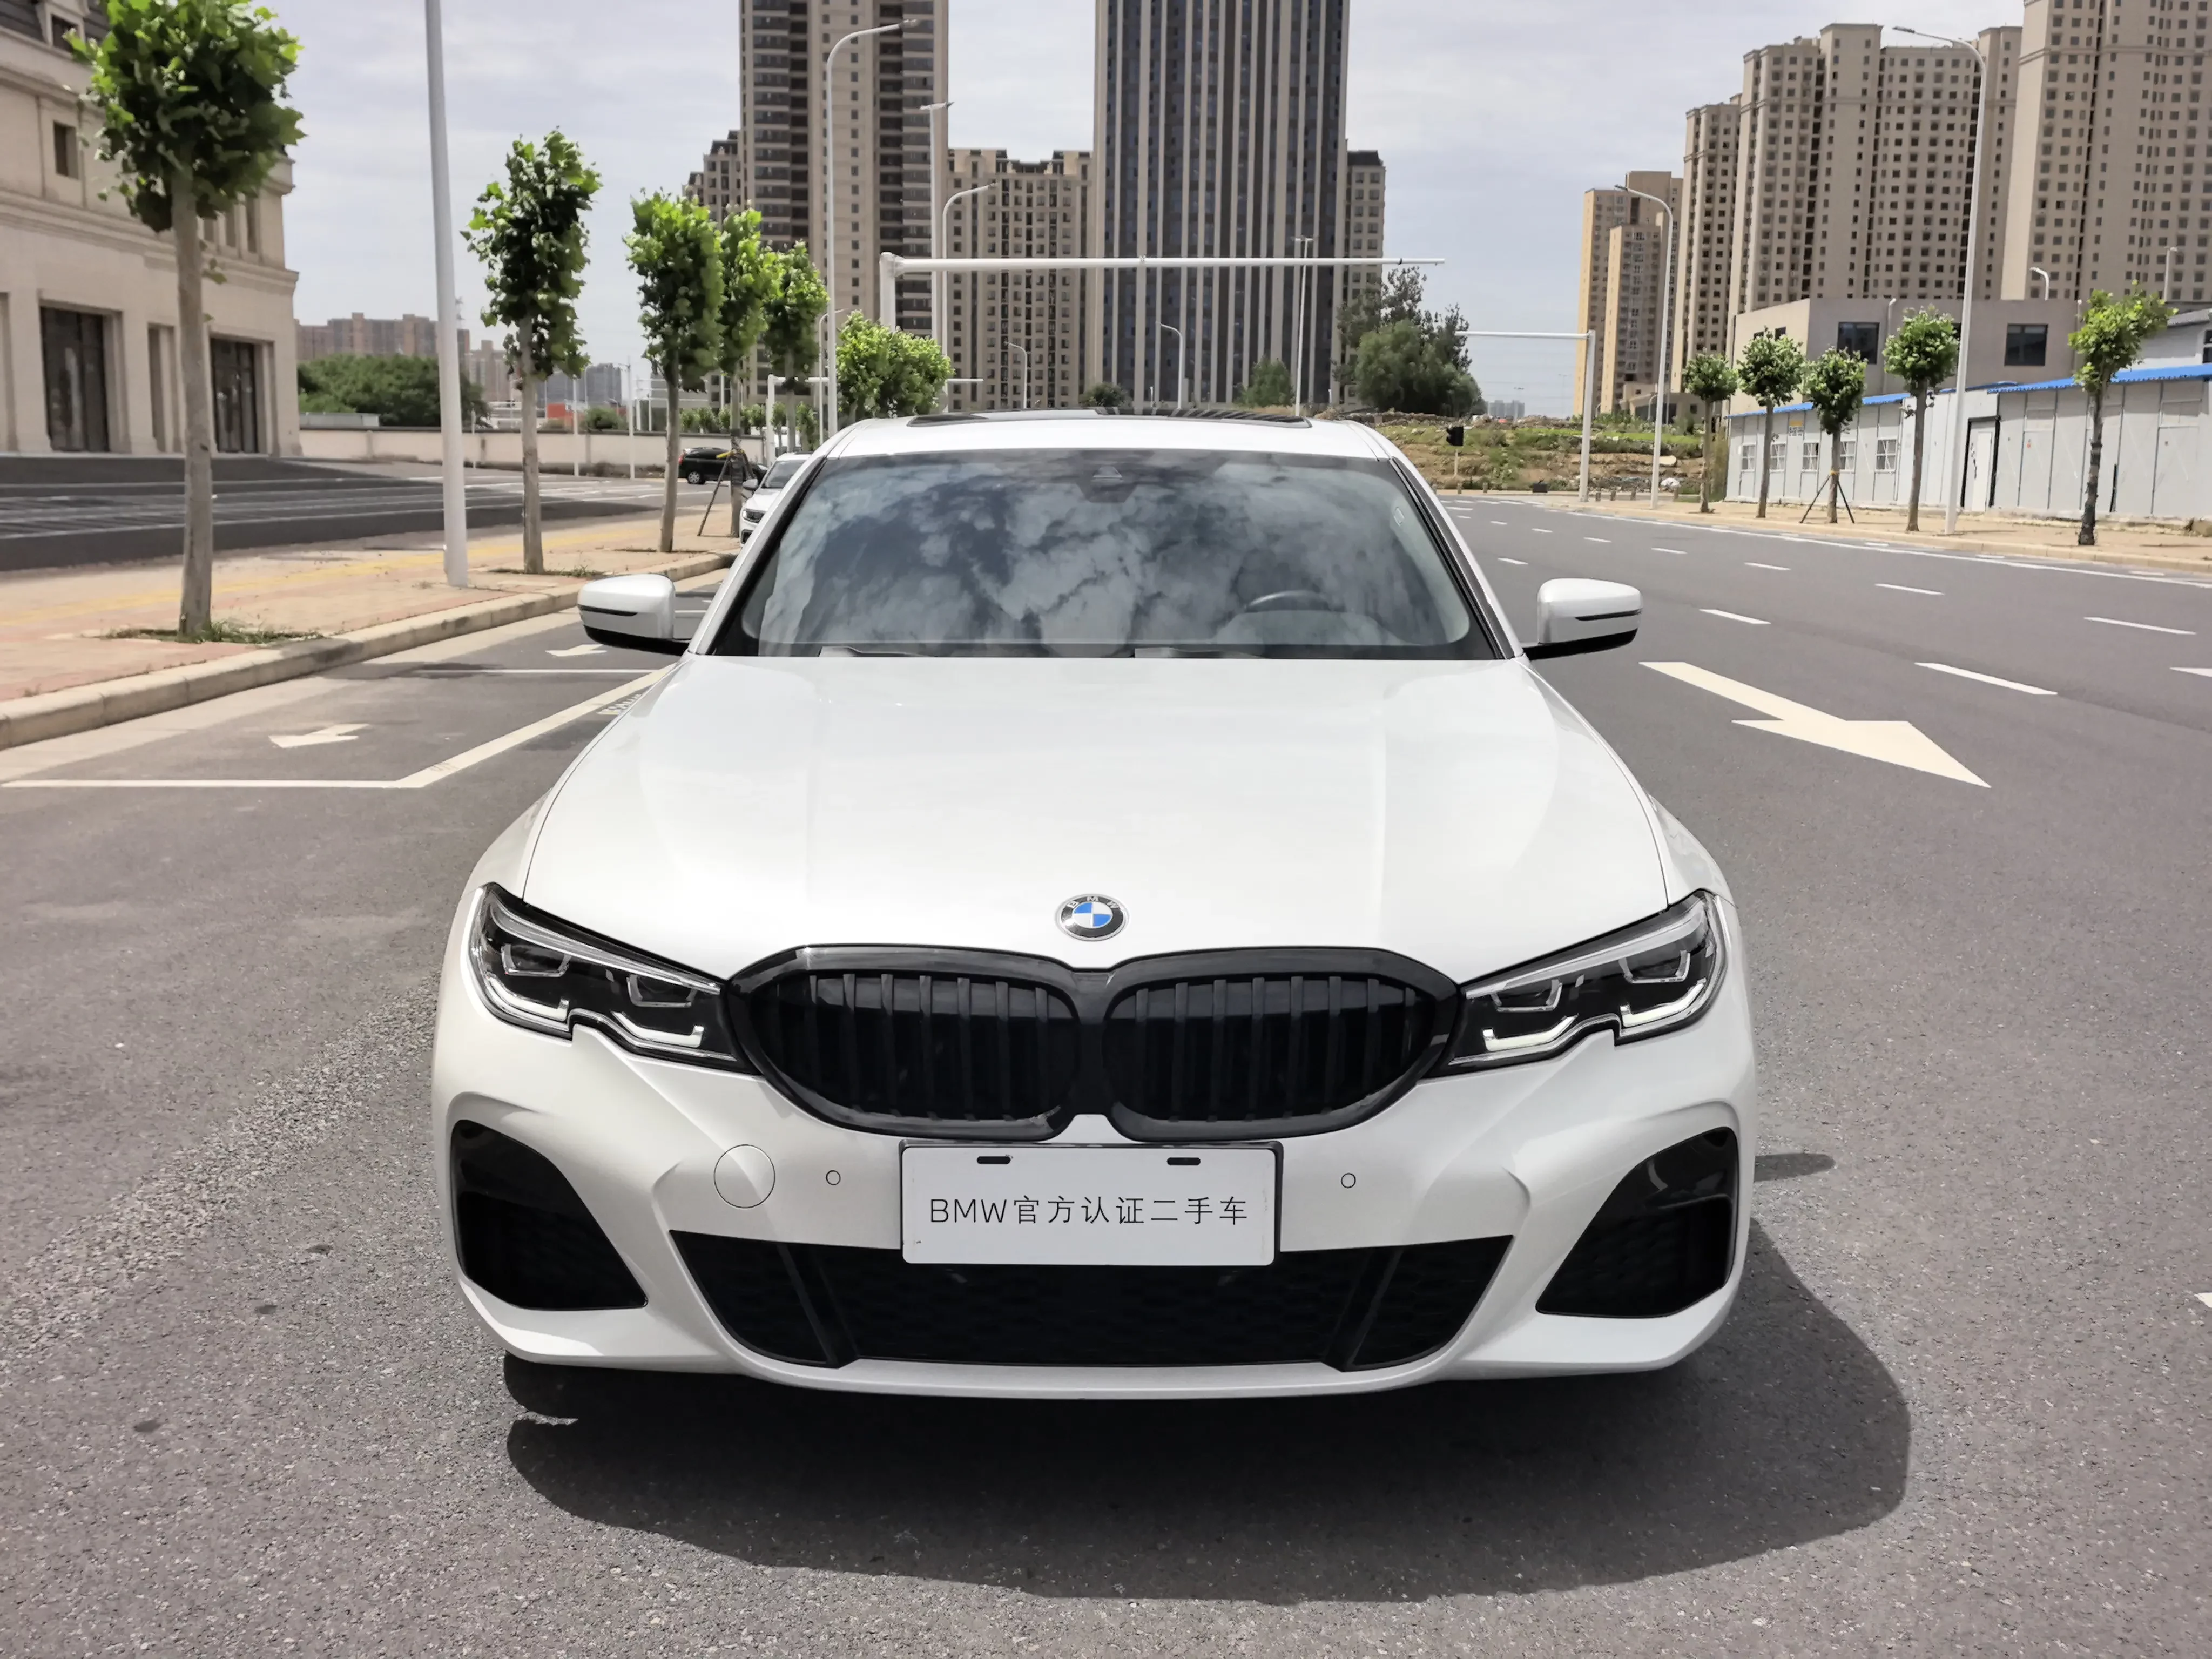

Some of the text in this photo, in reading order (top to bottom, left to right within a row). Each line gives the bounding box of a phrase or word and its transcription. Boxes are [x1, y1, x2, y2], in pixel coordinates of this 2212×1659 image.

[1067, 896, 1120, 909] BMW
[930, 1195, 1247, 1225] BMW官方认证二手车
